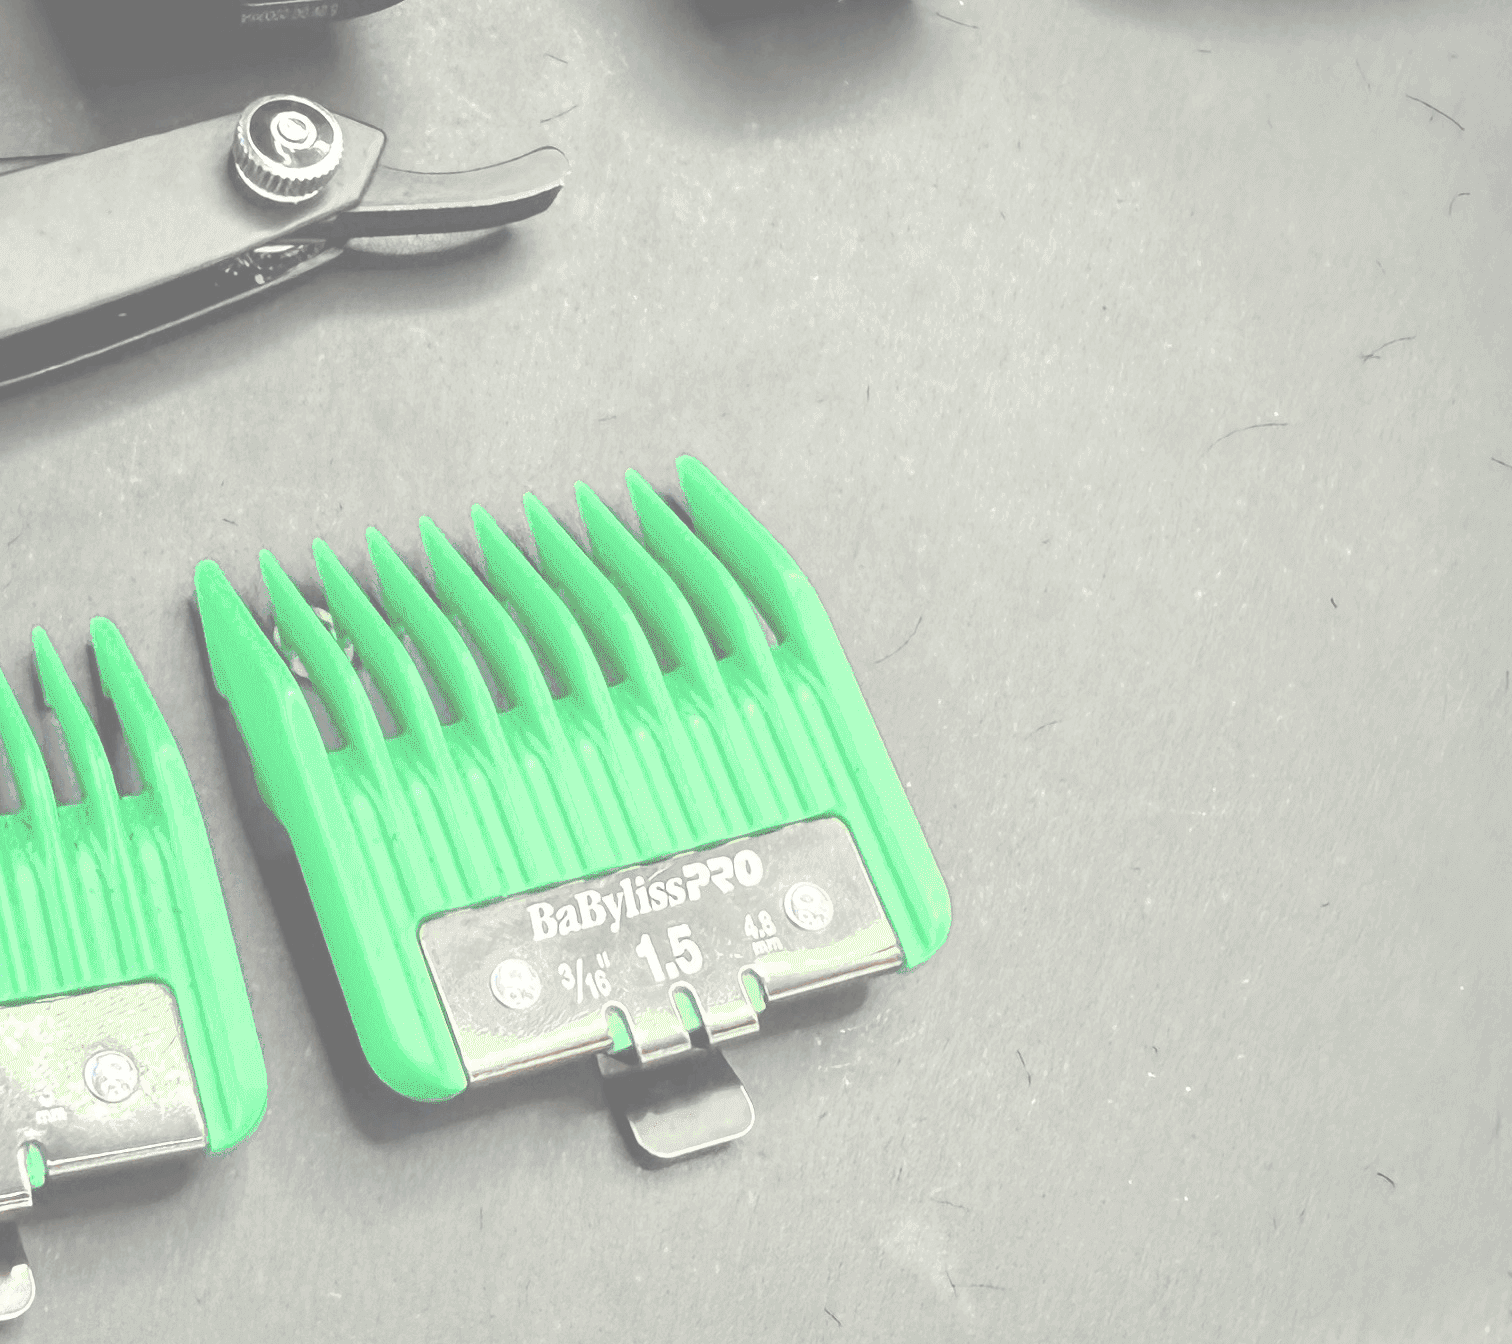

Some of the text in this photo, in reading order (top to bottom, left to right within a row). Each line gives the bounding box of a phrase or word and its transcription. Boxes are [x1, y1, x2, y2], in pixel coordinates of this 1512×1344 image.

[527, 848, 765, 943] BaBylissPRO
[744, 909, 776, 939] 4.8
[751, 934, 785, 955] mm
[635, 923, 704, 984] 1.5
